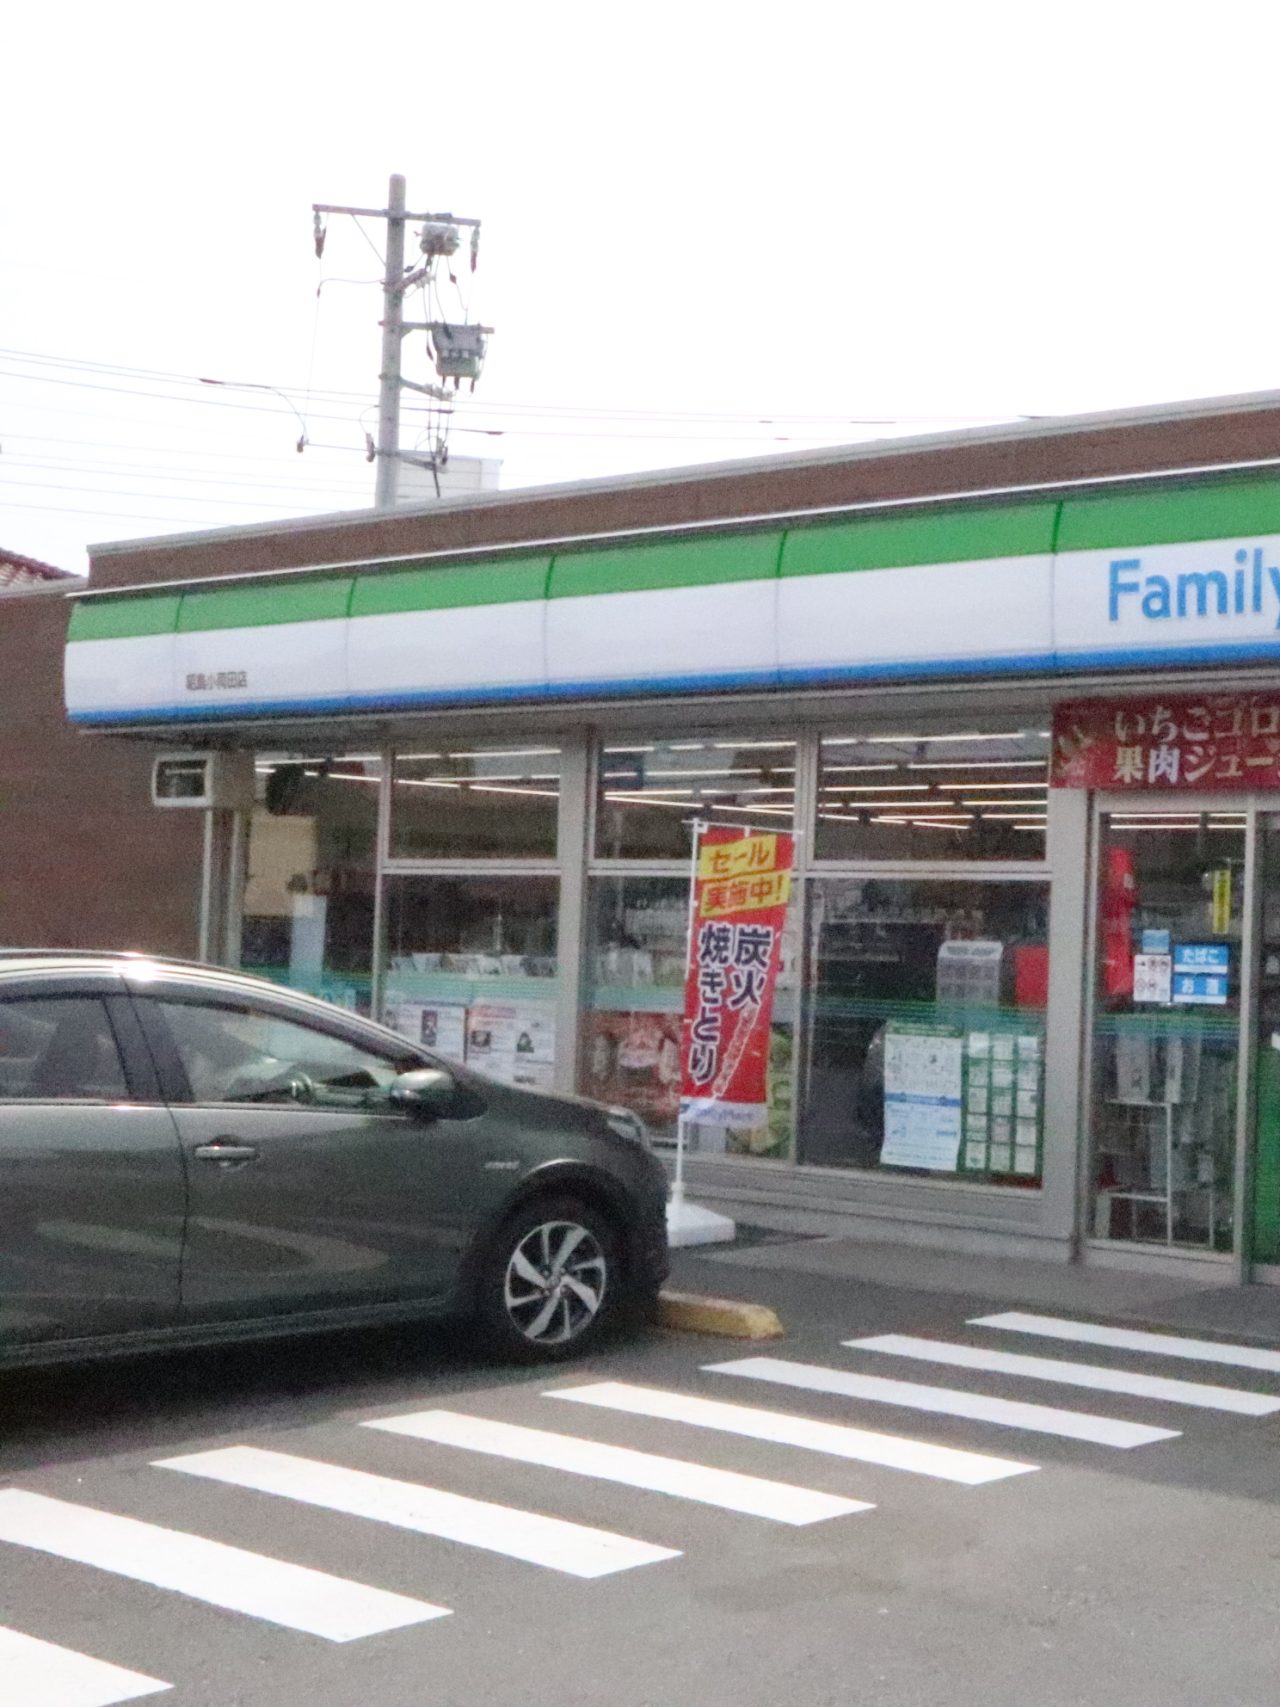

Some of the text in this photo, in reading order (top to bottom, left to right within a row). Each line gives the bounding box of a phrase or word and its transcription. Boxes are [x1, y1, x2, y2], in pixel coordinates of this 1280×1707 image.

[709, 841, 770, 874] セール
[728, 924, 774, 1009] 炭火
[1182, 947, 1220, 964] たばこ
[689, 921, 734, 1085] 焼きとり
